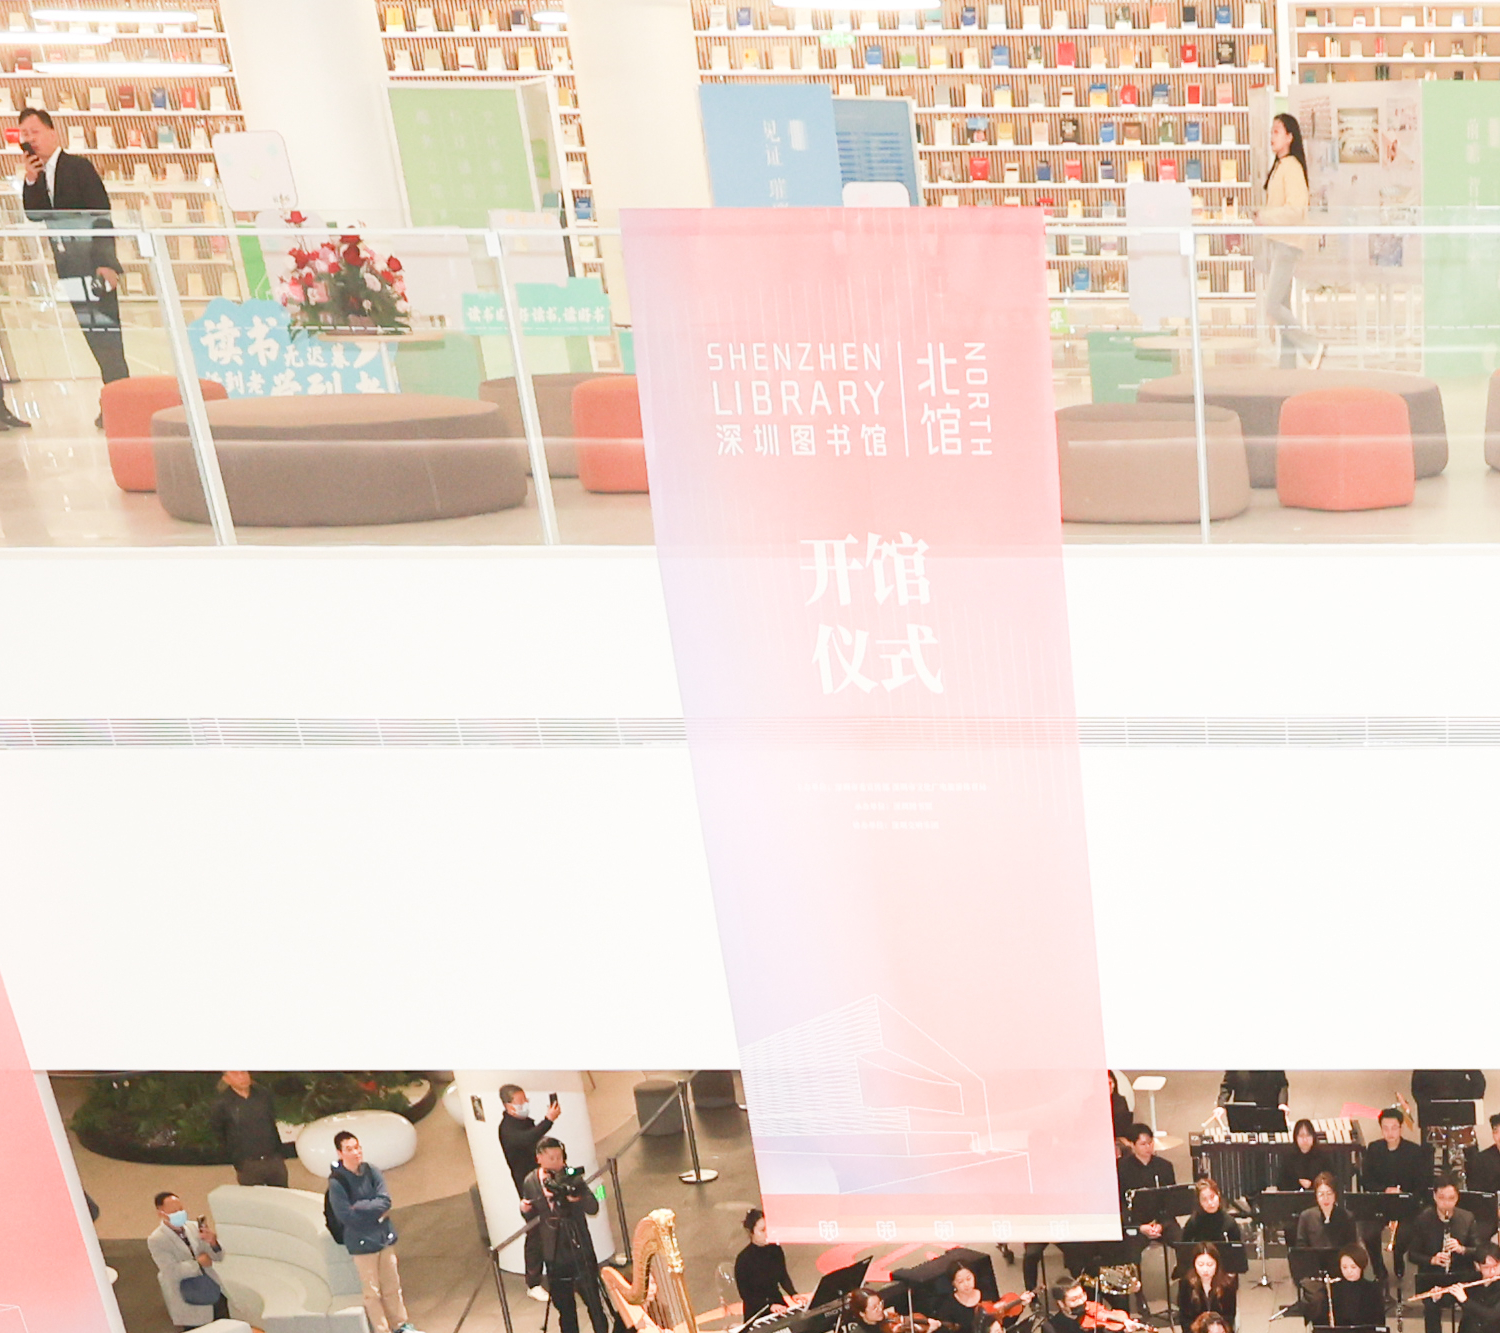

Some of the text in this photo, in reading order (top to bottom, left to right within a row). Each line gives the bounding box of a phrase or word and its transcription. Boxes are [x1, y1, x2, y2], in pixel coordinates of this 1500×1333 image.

[200, 313, 280, 367] 读书
[706, 341, 883, 372] SHENZHEN
[711, 379, 886, 417] LIBRARY
[916, 344, 962, 456] 北馆
[963, 341, 993, 456] NORTH
[715, 423, 888, 457] 深圳图书馆
[798, 531, 932, 608] 开馆
[810, 622, 944, 696] 仪式
